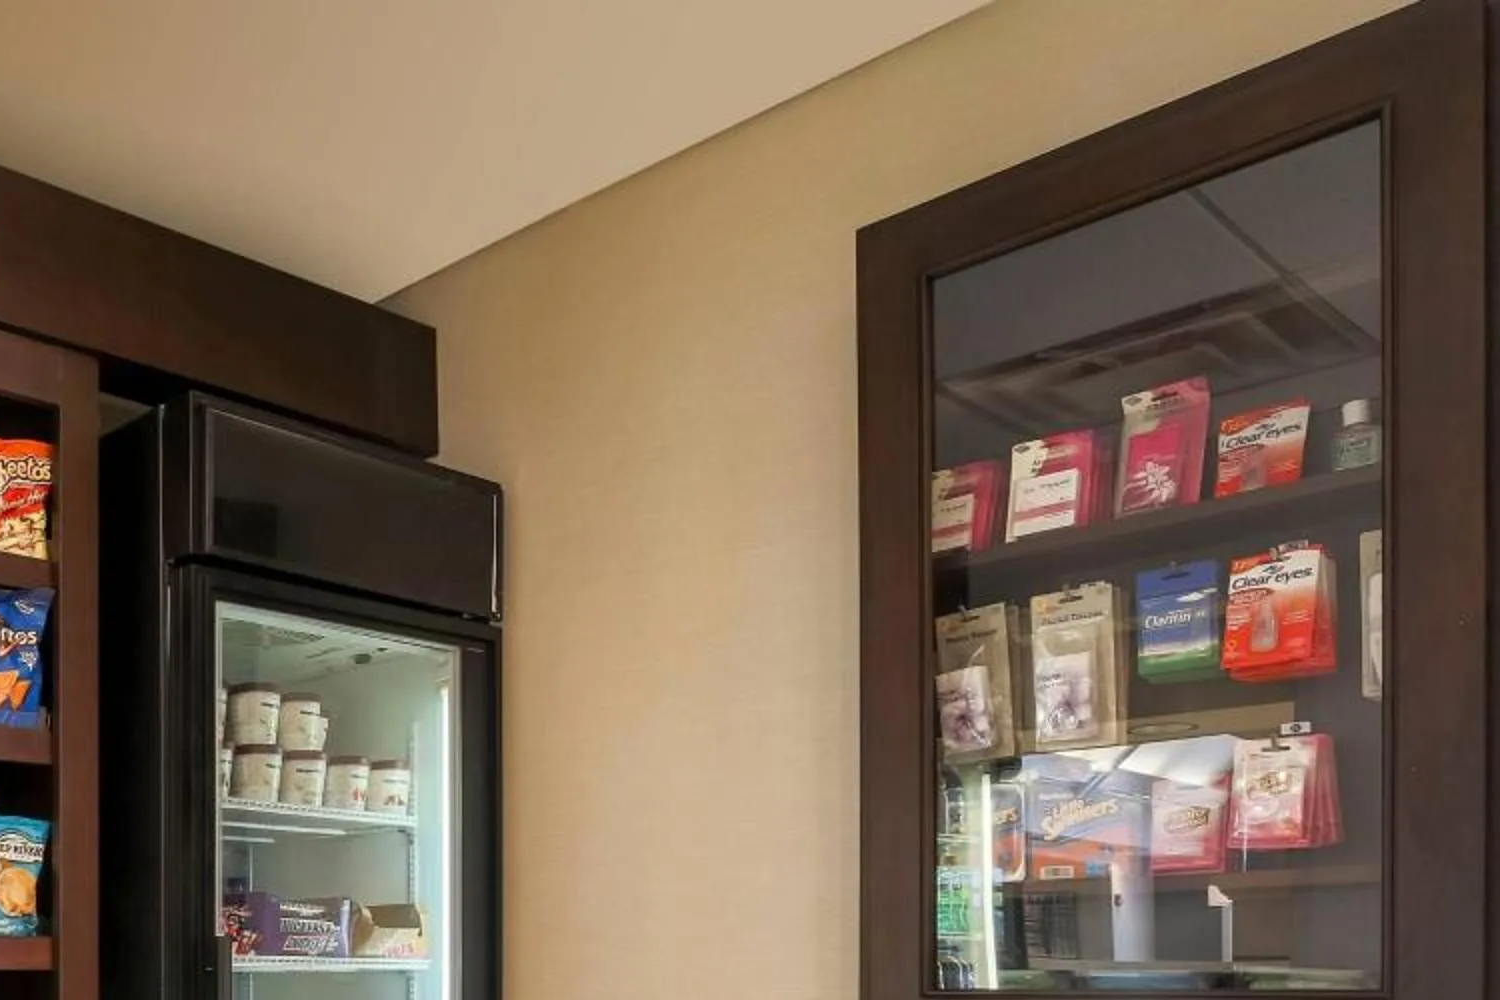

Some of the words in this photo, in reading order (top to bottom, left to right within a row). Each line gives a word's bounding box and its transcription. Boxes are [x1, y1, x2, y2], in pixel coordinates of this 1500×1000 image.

[1226, 433, 1262, 450] Clear
[1265, 423, 1303, 440] eyes
[1231, 575, 1272, 590] Clear
[1274, 567, 1313, 584] eyes
